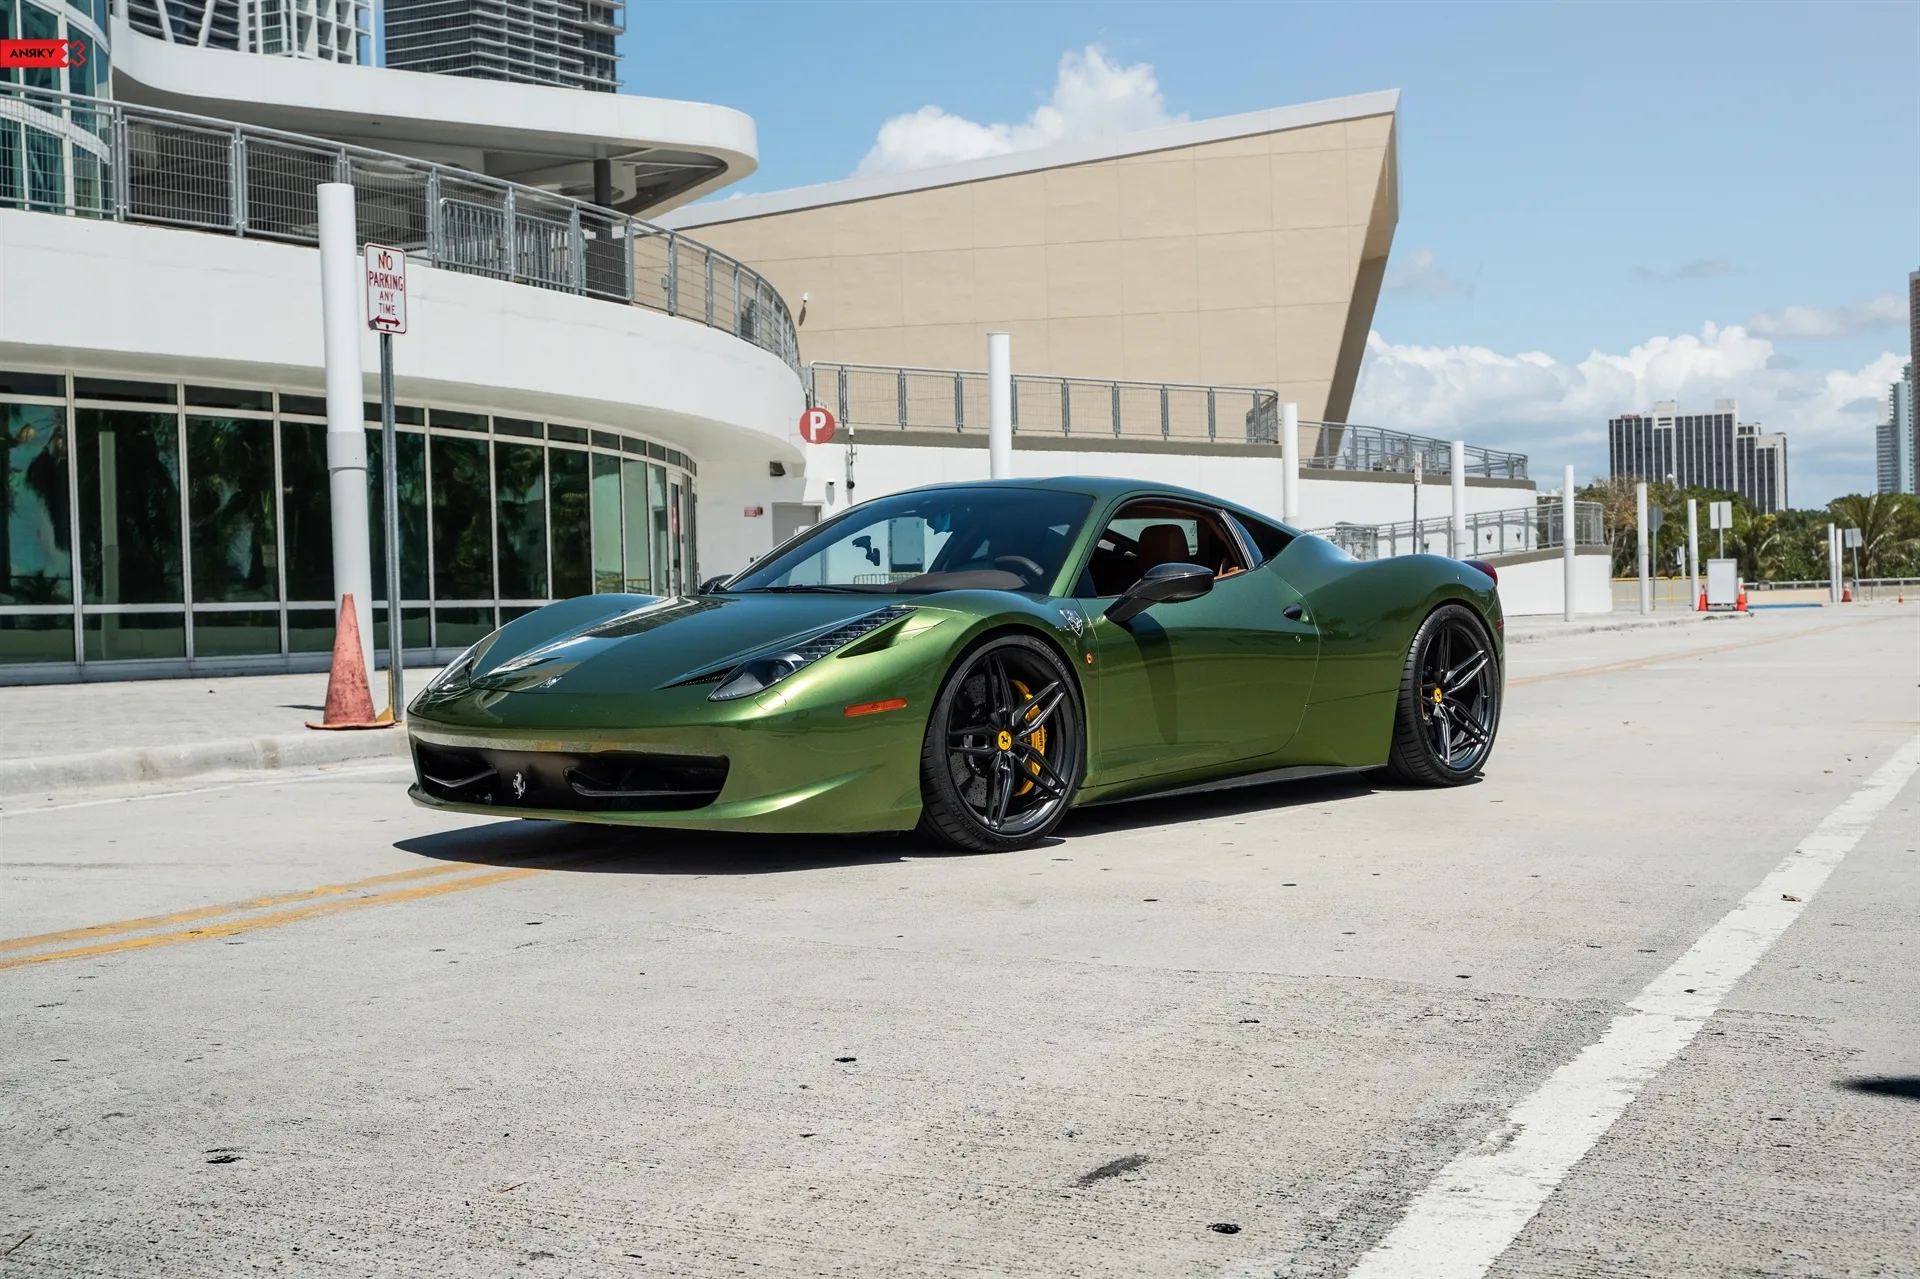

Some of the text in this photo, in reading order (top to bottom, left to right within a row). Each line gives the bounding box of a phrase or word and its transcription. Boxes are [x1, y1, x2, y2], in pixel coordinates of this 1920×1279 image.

[378, 253, 393, 271] NO
[368, 270, 404, 291] PARKING
[379, 291, 395, 303] ANY
[378, 302, 396, 315] TIME
[809, 411, 826, 441] P
